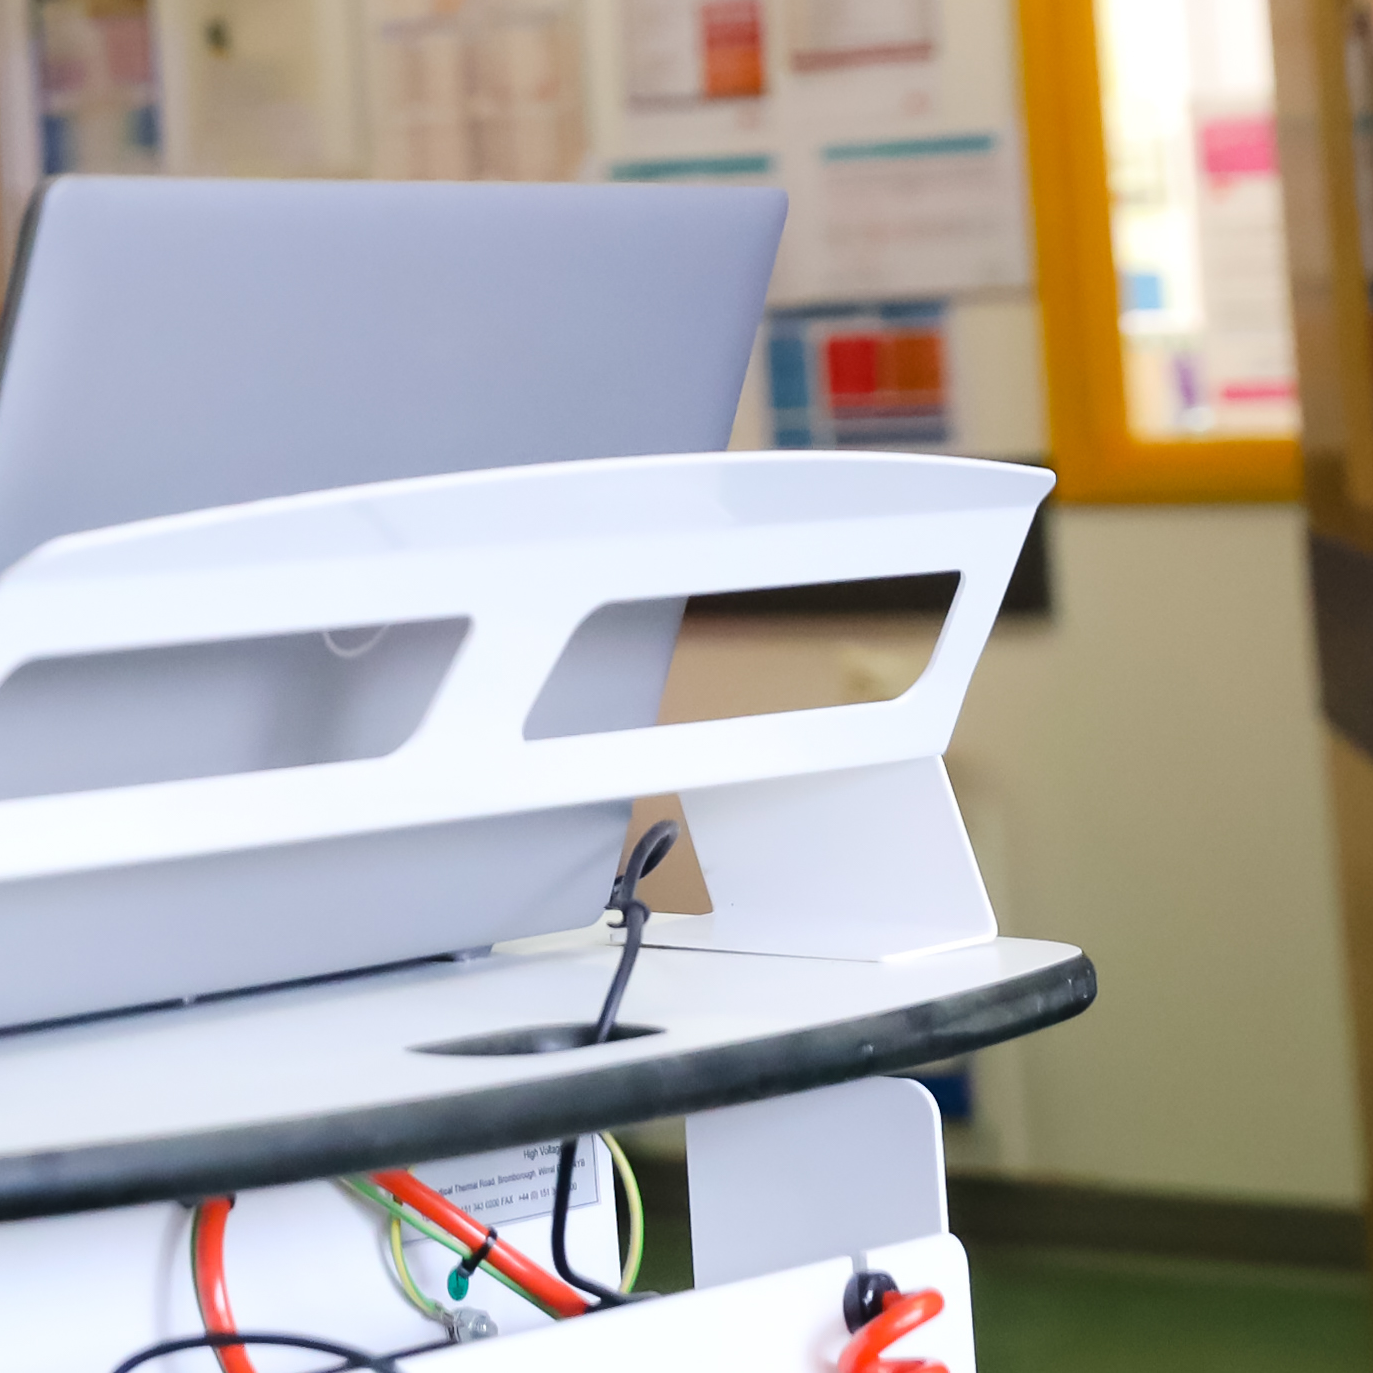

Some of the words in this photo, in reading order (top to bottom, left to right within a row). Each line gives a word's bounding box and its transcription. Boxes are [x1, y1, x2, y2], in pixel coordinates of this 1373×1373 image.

[523, 1148, 538, 1161] High
[539, 1144, 563, 1156] Voltag
[501, 1194, 514, 1206] FAX
[540, 1188, 550, 1197] 151
